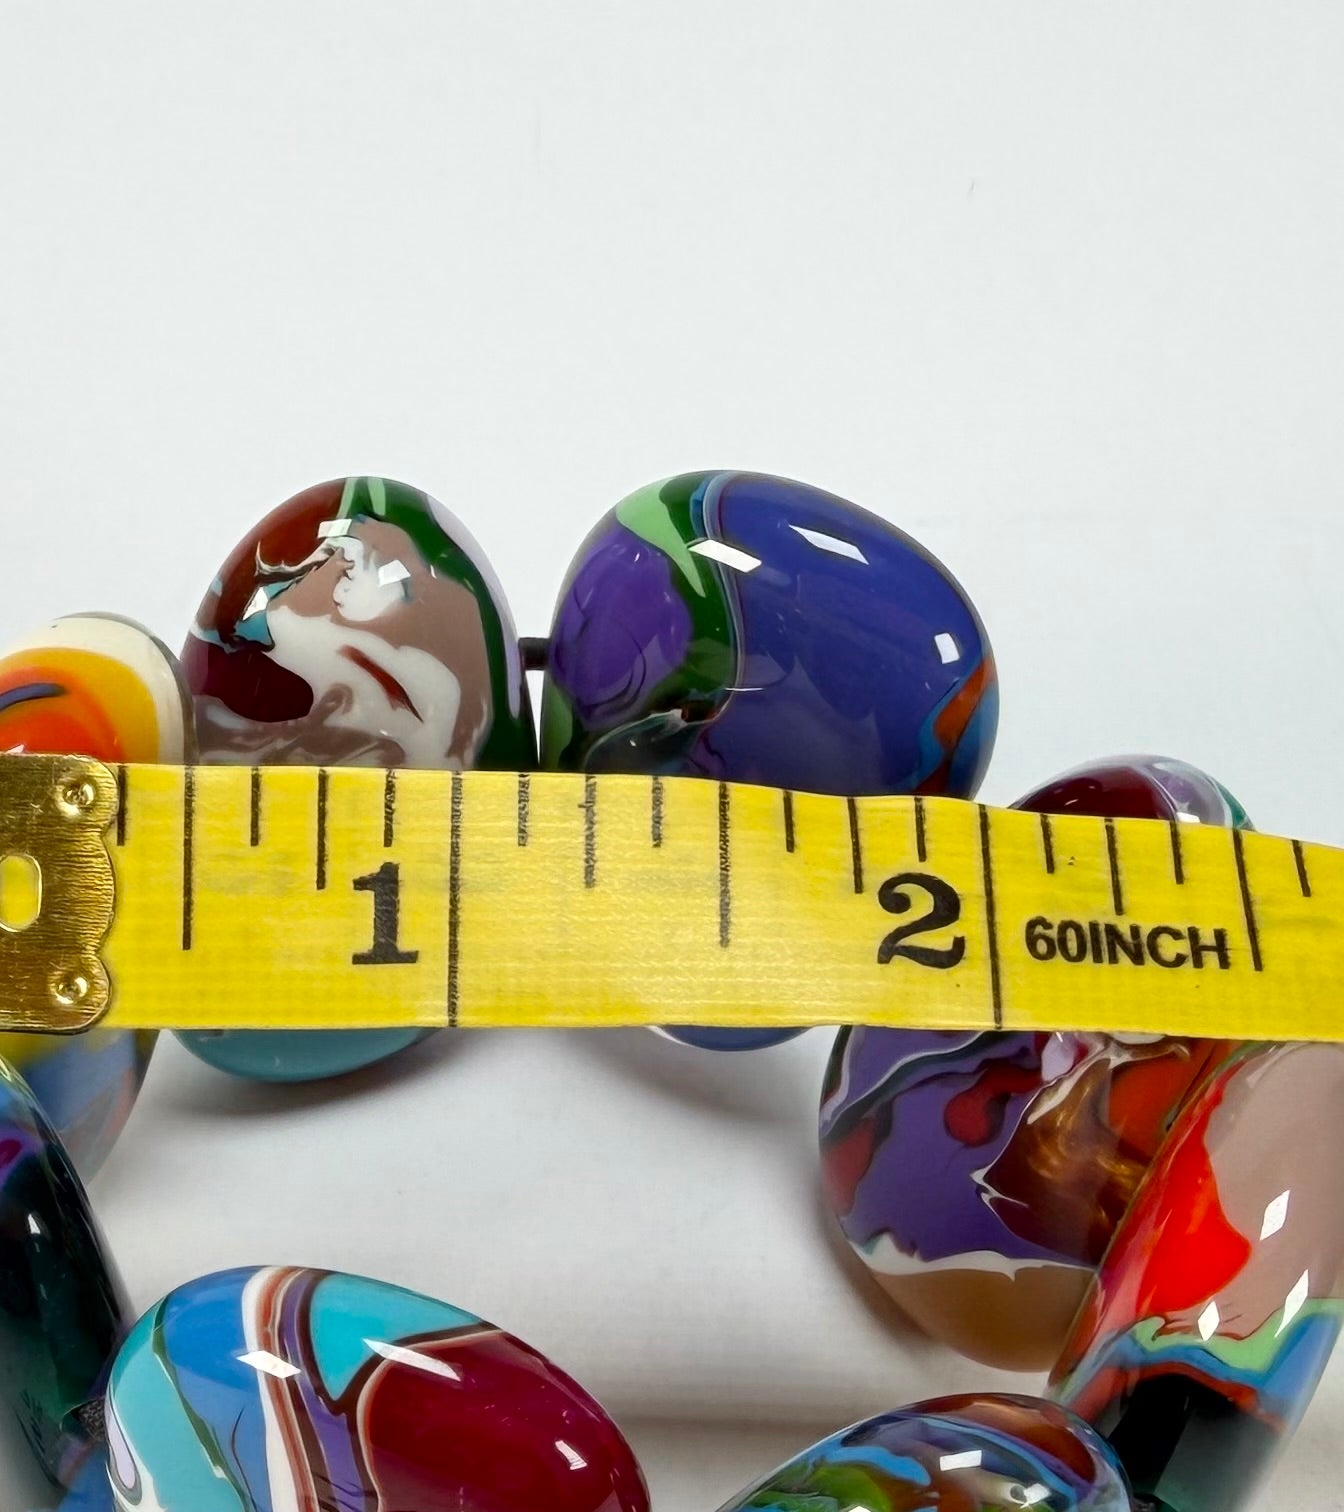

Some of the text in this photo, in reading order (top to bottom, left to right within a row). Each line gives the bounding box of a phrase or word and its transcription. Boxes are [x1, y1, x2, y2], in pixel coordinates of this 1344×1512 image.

[352, 862, 419, 965] 1
[877, 872, 966, 969] 2
[1024, 915, 1231, 971] 60INCH
